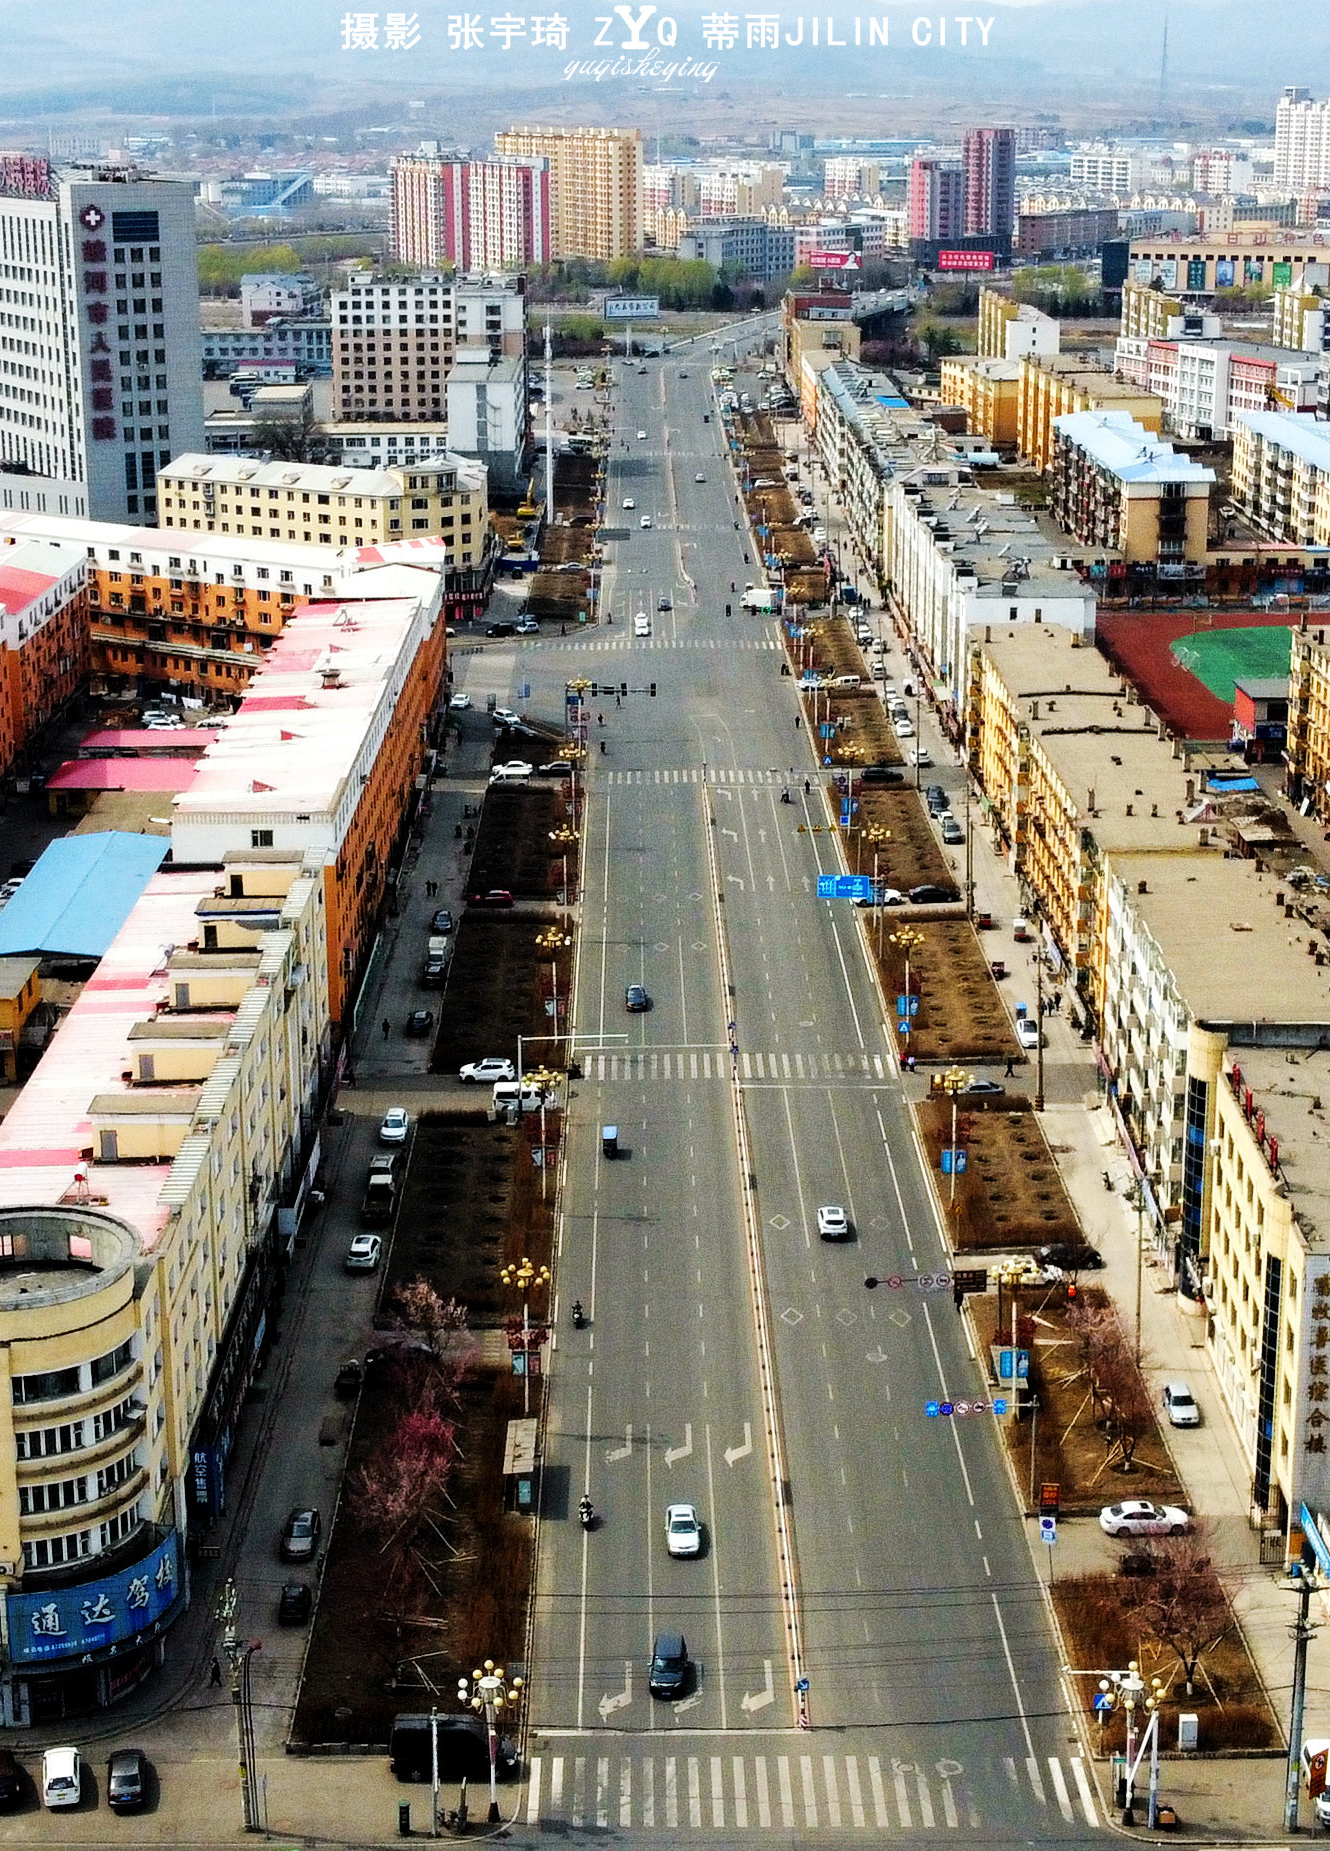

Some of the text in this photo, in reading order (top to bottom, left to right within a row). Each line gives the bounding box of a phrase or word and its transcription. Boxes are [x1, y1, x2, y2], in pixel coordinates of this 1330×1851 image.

[194, 1452, 208, 1503] 航空售票
[31, 1553, 173, 1635] 通达驾校
